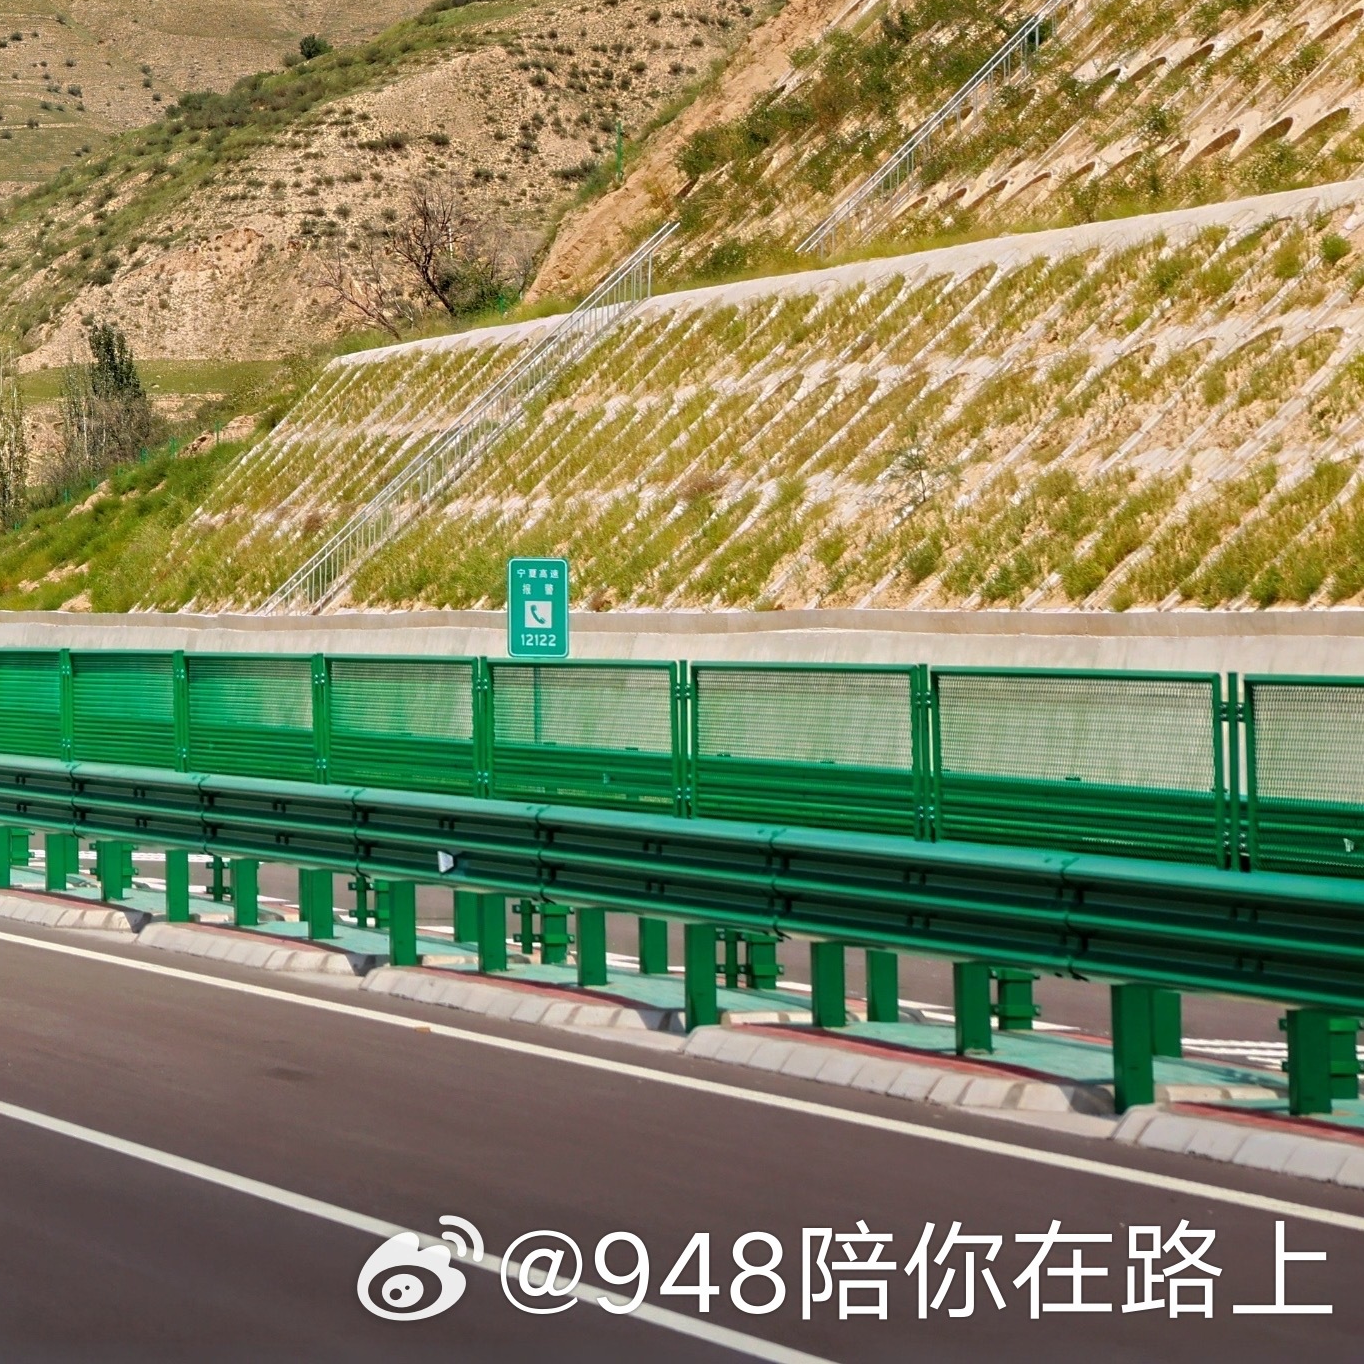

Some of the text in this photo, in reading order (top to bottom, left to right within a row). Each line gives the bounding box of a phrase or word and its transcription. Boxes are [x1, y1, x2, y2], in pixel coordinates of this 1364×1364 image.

[516, 568, 559, 579] 宁夏高速
[520, 633, 557, 647] 12122
